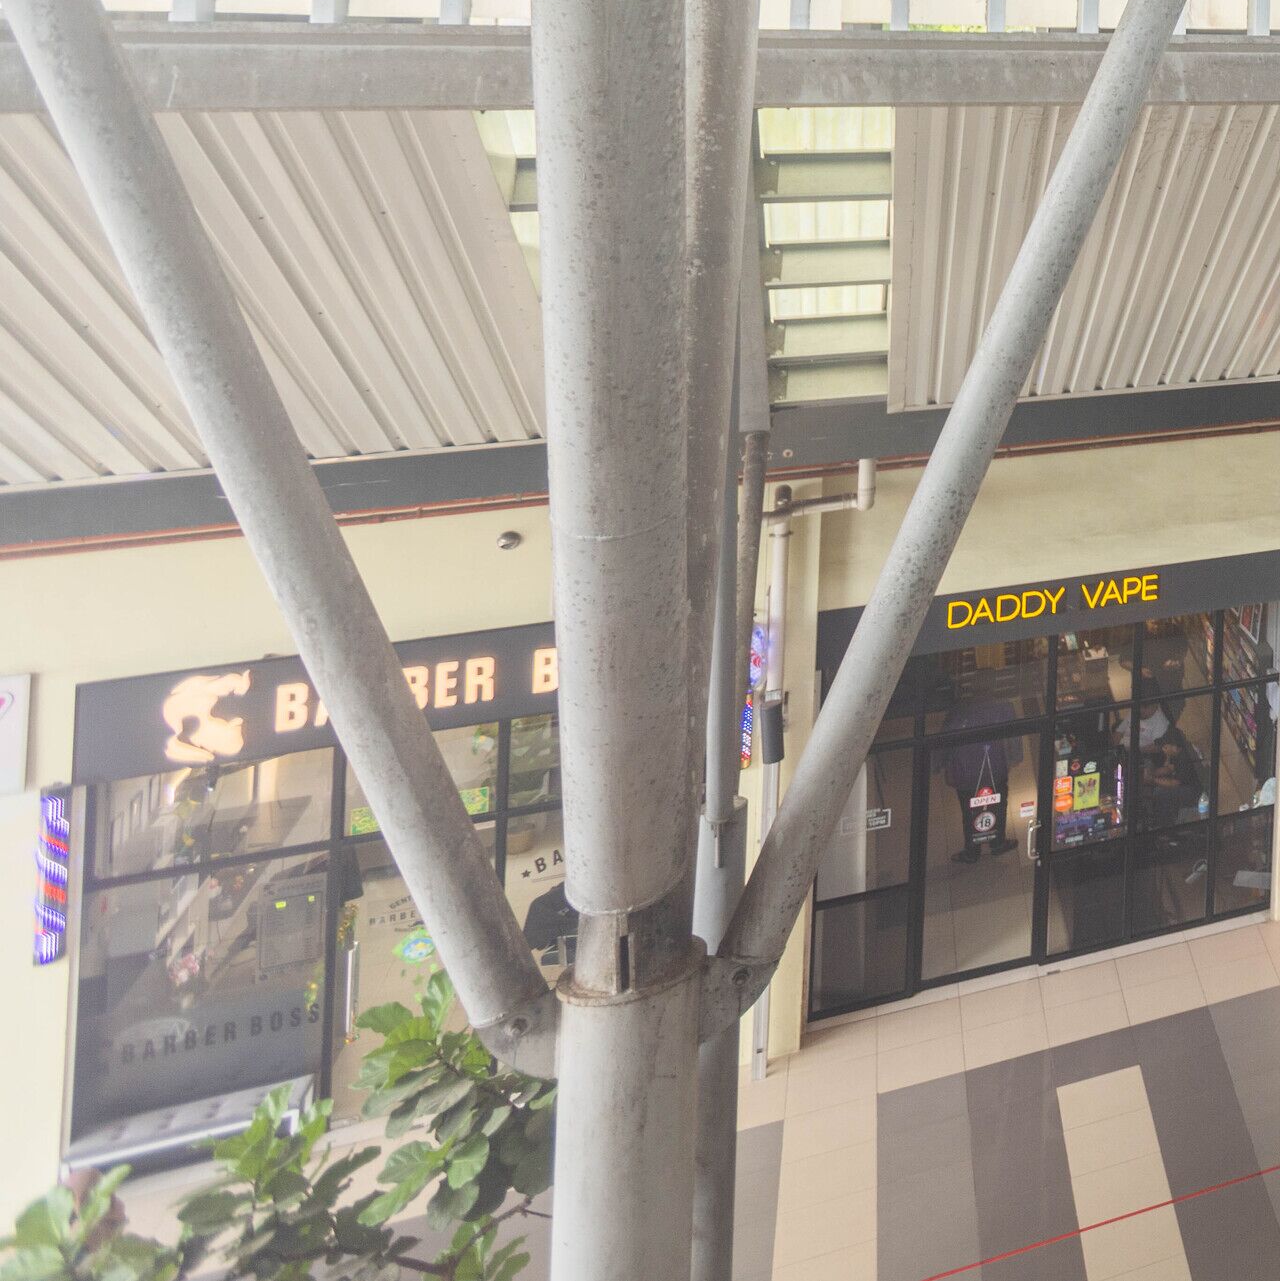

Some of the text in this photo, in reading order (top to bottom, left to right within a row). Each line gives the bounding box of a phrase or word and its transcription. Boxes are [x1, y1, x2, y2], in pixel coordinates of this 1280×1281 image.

[947, 574, 1159, 629] DADDY VAPE
[275, 656, 497, 732] BBER
[973, 795, 998, 806] OPEN
[369, 910, 417, 926] BARBE
